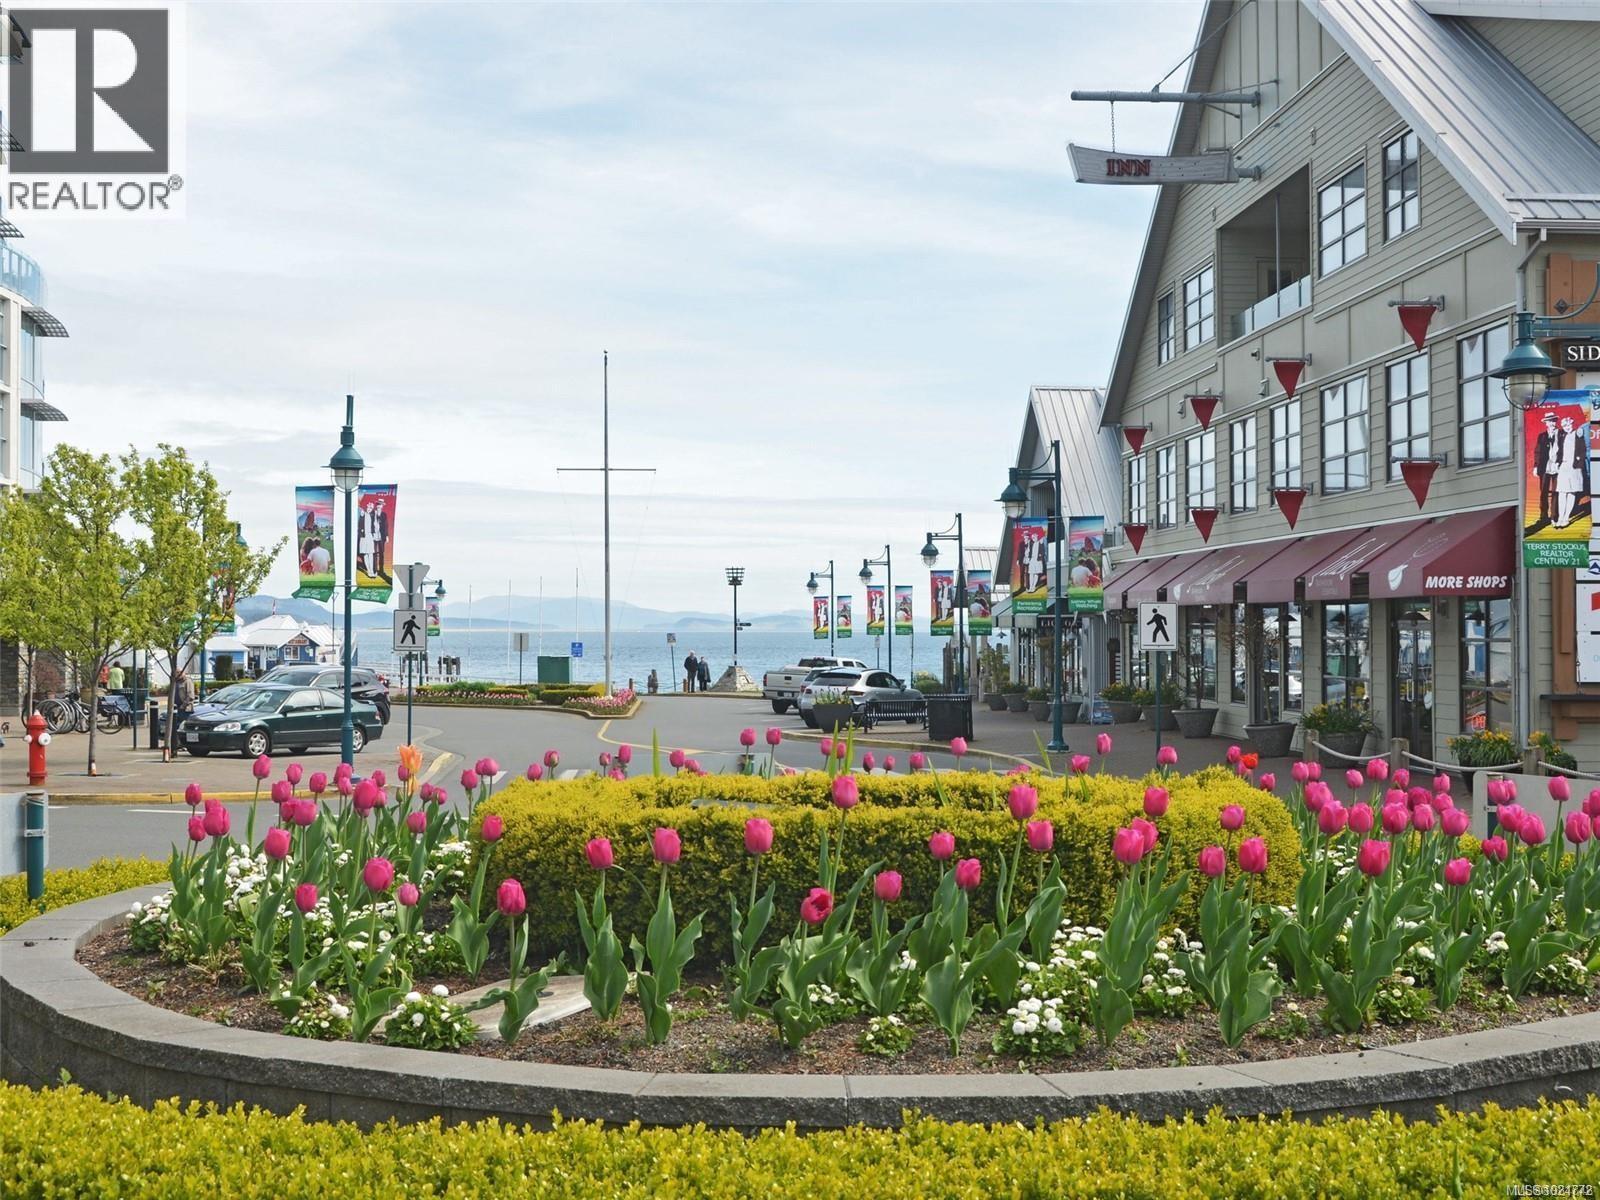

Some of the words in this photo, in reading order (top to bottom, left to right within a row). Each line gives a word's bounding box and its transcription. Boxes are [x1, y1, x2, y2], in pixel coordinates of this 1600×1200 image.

[1106, 158, 1151, 176] INN
[1534, 557, 1569, 565] CENTURY
[1425, 576, 1463, 588] MORE
[1466, 576, 1508, 588] SHOPS
